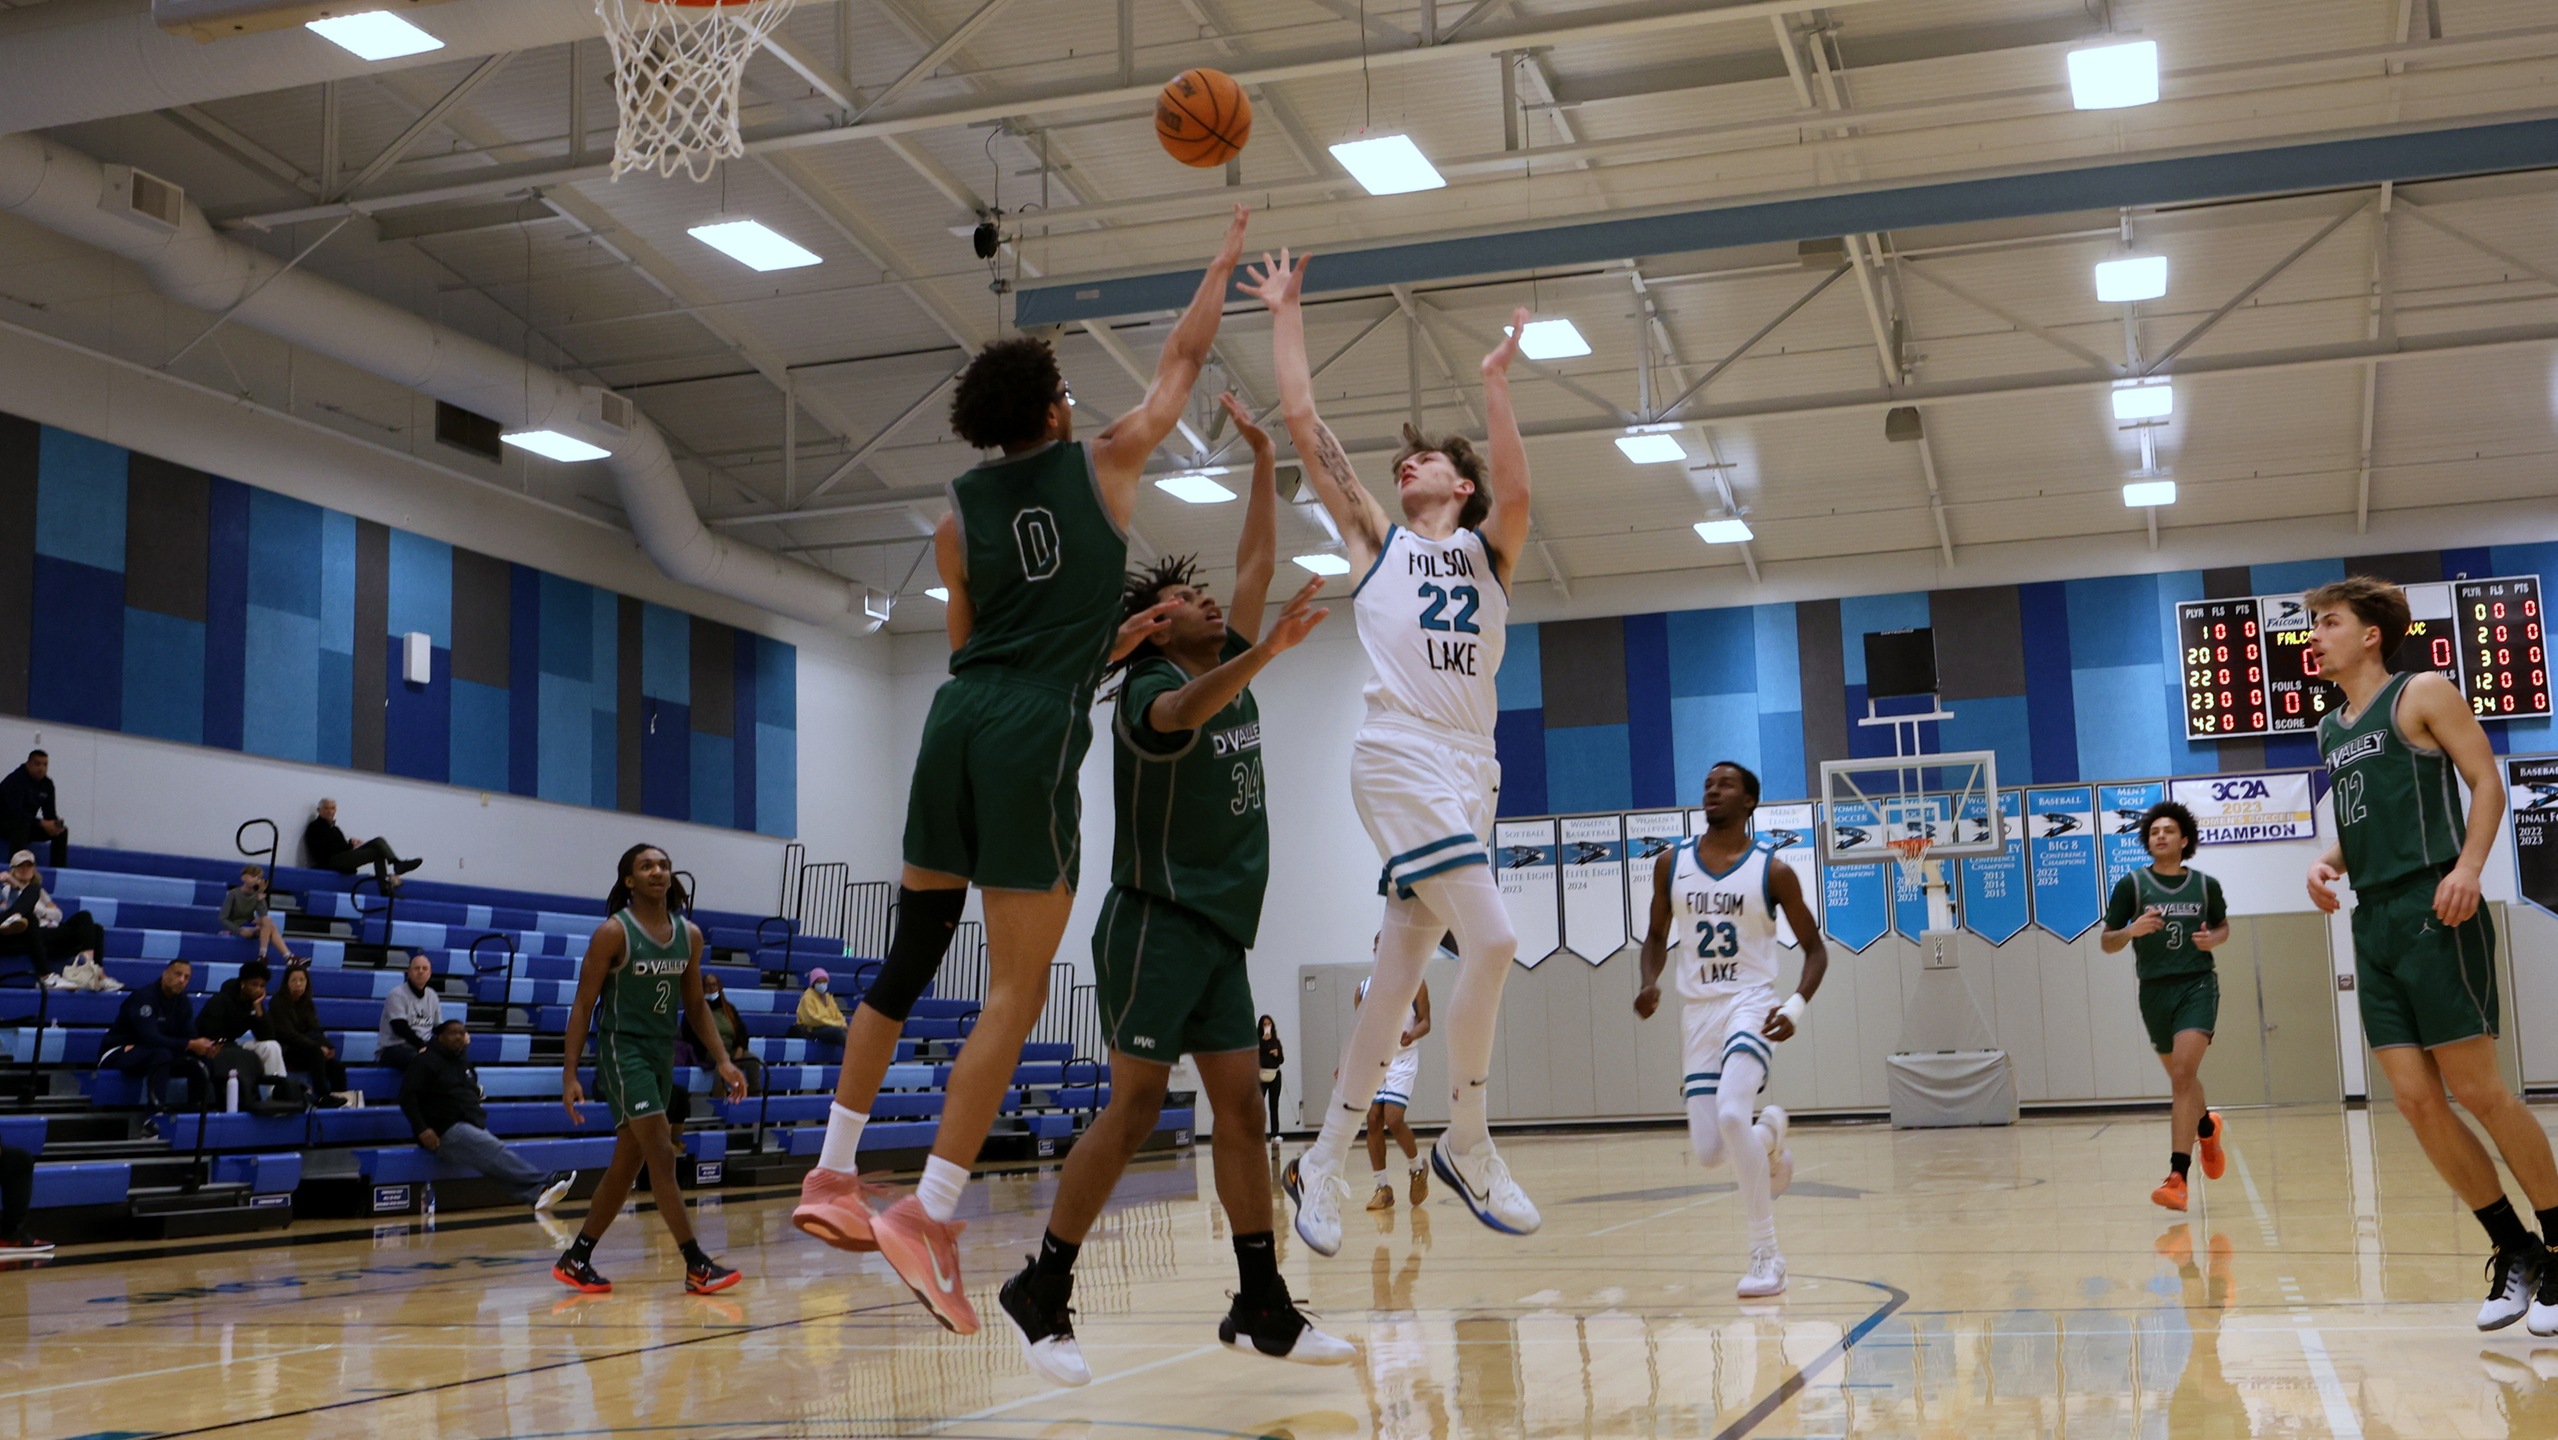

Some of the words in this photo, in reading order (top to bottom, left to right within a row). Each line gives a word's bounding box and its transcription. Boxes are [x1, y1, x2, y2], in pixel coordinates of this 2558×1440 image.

[1012, 506, 1060, 581] 0
[2462, 587, 2481, 598] PLYR
[2490, 585, 2504, 596] FLS
[2514, 583, 2529, 594] PTS
[1418, 581, 1480, 635] 22
[2186, 608, 2204, 619] PLYR
[2212, 606, 2225, 617] FLS
[2236, 605, 2250, 615] PTS
[2475, 603, 2486, 621] 0
[2494, 603, 2505, 619] 0
[2525, 600, 2536, 616] 0
[2266, 618, 2305, 628] FALCONS
[2203, 625, 2209, 640] 1
[2215, 624, 2226, 640] 0
[2245, 621, 2256, 637] 0
[2477, 626, 2488, 644] 2
[2496, 625, 2507, 642] 0
[2527, 623, 2538, 640] 0
[1427, 639, 1477, 676] LAKE
[2188, 647, 2210, 665] 20
[2217, 646, 2228, 662] 0
[2247, 644, 2258, 660] 0
[2432, 638, 2451, 667] 0
[2481, 649, 2491, 667] 3
[2499, 648, 2510, 665] 0
[2530, 646, 2541, 663] 0
[2189, 670, 2212, 688] 22
[2219, 669, 2230, 685] 0
[2249, 667, 2260, 683] 0
[2476, 672, 2493, 690] 12
[2501, 671, 2512, 688] 0
[2532, 669, 2543, 686] 0
[2272, 680, 2302, 692] FOULS
[2191, 692, 2214, 710] 23
[2221, 691, 2232, 707] 0
[2251, 689, 2262, 705] 0
[2285, 692, 2300, 714] 0
[2313, 694, 2325, 712] 6
[2473, 696, 2496, 714] 34
[2503, 694, 2514, 711] 0
[2534, 693, 2546, 709] 0
[2193, 715, 2215, 732] 42
[2223, 714, 2234, 730] 0
[2253, 712, 2264, 728] 0
[2275, 718, 2305, 730] SCORE
[1230, 757, 1261, 816] 34
[2117, 786, 2147, 796] MEN'S
[2211, 780, 2270, 801] 3C2A
[2038, 795, 2082, 806] BASEBALL
[2118, 797, 2145, 806] GOLF
[2338, 770, 2367, 827] 12
[2222, 802, 2263, 815] 2023
[1570, 820, 1611, 829] WOMEN'S
[1635, 815, 1675, 824] WOMEN'S
[2198, 815, 2244, 827] OMEN'S
[2249, 813, 2294, 824] SOCCER
[2515, 813, 2547, 824] FINAL
[1505, 829, 1545, 839] SOFTBALL
[1565, 829, 1616, 839] BASKETBALL
[1631, 825, 1679, 834] VOLLEYBALL
[2519, 826, 2543, 837] 2022
[2048, 840, 2069, 851] BIG
[2071, 840, 2079, 850] 8
[2519, 836, 2543, 846] 2023
[2040, 851, 2087, 860] CONFERENCE
[1971, 863, 2016, 871] CHAMPIONS
[2041, 858, 2086, 867] CHAMPIONS
[1501, 872, 1523, 882] ELITE
[1527, 871, 1554, 881] EIGHT
[1565, 869, 1588, 879] ELITE
[1592, 868, 1619, 878] EIGHT
[1632, 874, 1652, 883] 2017
[1832, 871, 1875, 879] CHAMPIONS
[1983, 871, 2005, 880] 2013
[2036, 868, 2058, 877] 2022
[1567, 882, 1587, 890] 2024
[1826, 880, 1848, 890] 2016
[1984, 880, 2005, 889] 2014
[2037, 877, 2059, 887] 2024
[1502, 886, 1522, 894] 2023
[1827, 889, 1848, 898] 2017
[1686, 892, 1744, 916] FOLSOM
[1828, 897, 1849, 906] 2022
[1696, 920, 1739, 958] 23
[2166, 921, 2183, 950] 3
[1700, 962, 1738, 985] LAKE
[653, 980, 671, 1014] 2
[1133, 1035, 1156, 1049] DVC
